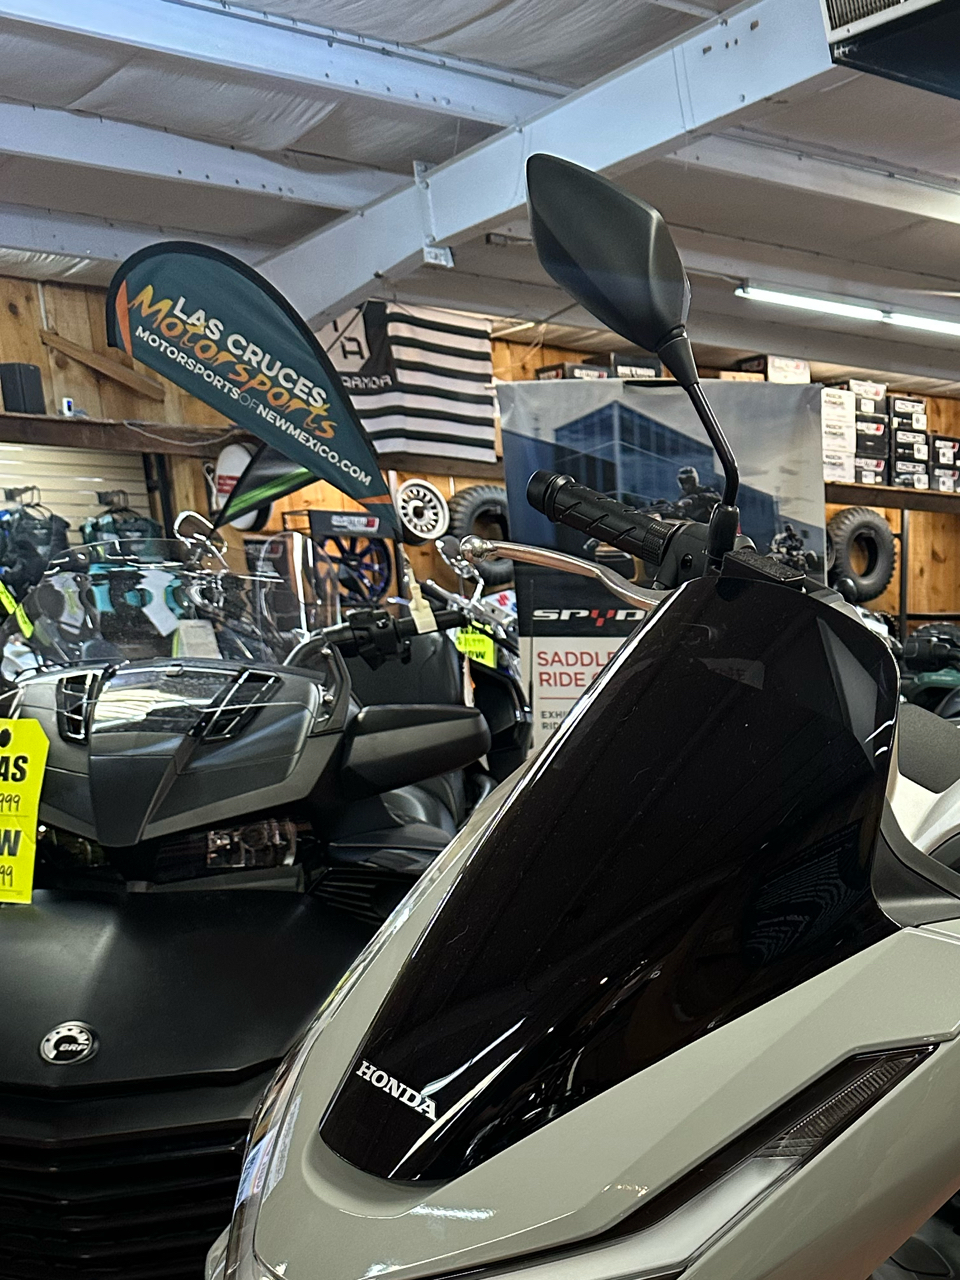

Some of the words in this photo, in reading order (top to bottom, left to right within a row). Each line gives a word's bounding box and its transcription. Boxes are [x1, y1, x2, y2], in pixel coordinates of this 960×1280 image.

[173, 296, 224, 340] LAS
[226, 333, 328, 407] CRUCES
[135, 326, 372, 486] MOTORSPORTSOFNEWMEXICO.COM
[539, 672, 587, 687] RIDE
[59, 1043, 88, 1051] BRP
[355, 1060, 437, 1122] HONDA
